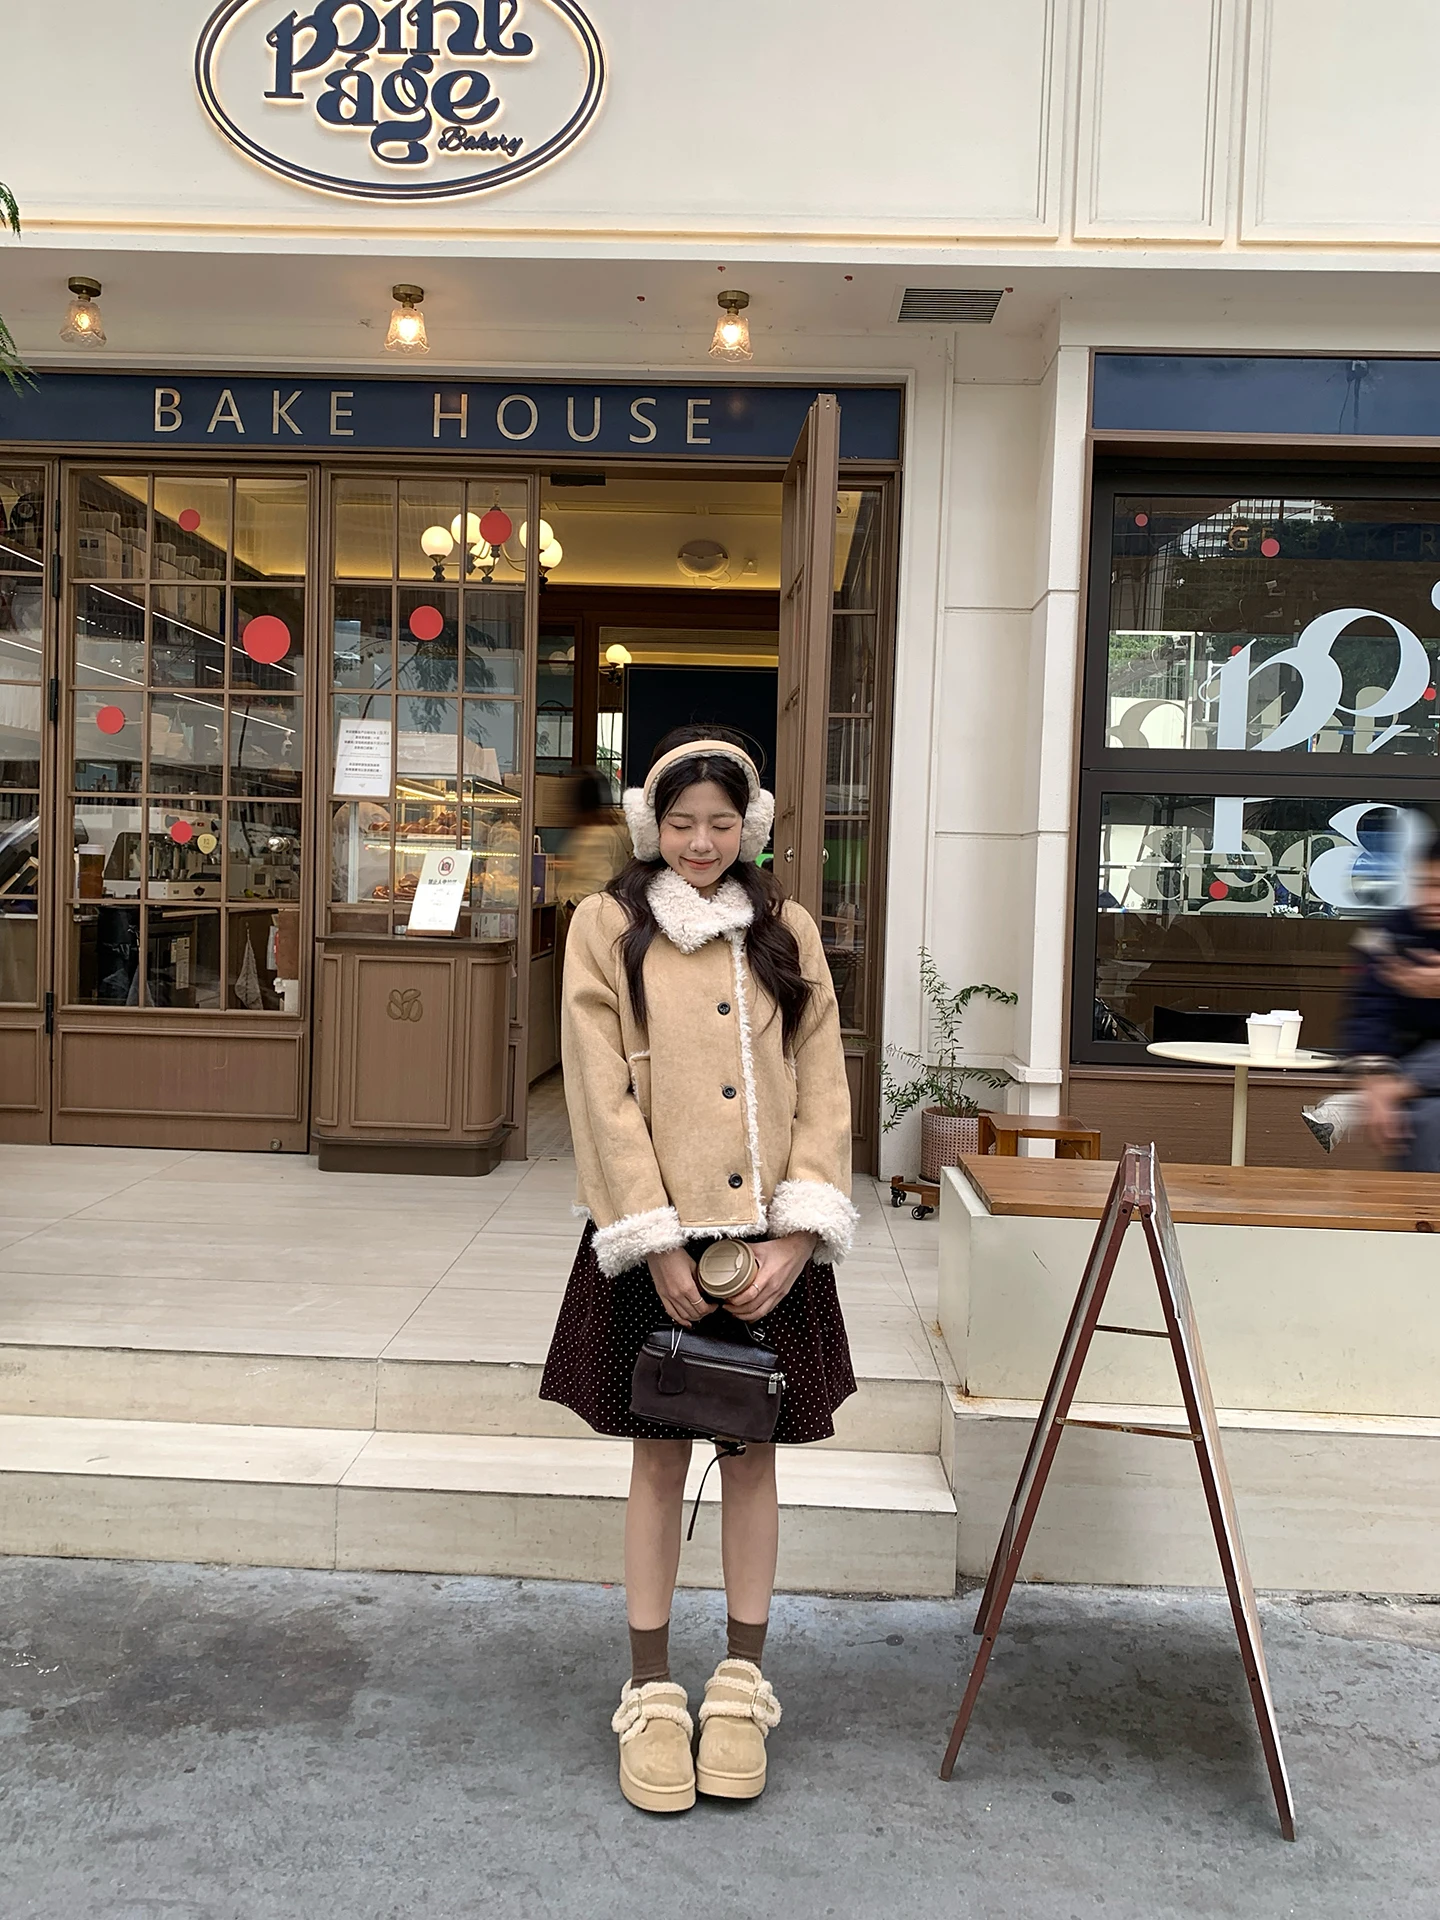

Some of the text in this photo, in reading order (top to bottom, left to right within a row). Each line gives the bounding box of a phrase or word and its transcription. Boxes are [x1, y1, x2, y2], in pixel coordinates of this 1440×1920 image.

[437, 126, 524, 157] Bakery
[153, 387, 712, 445] BAKE HOUSE
